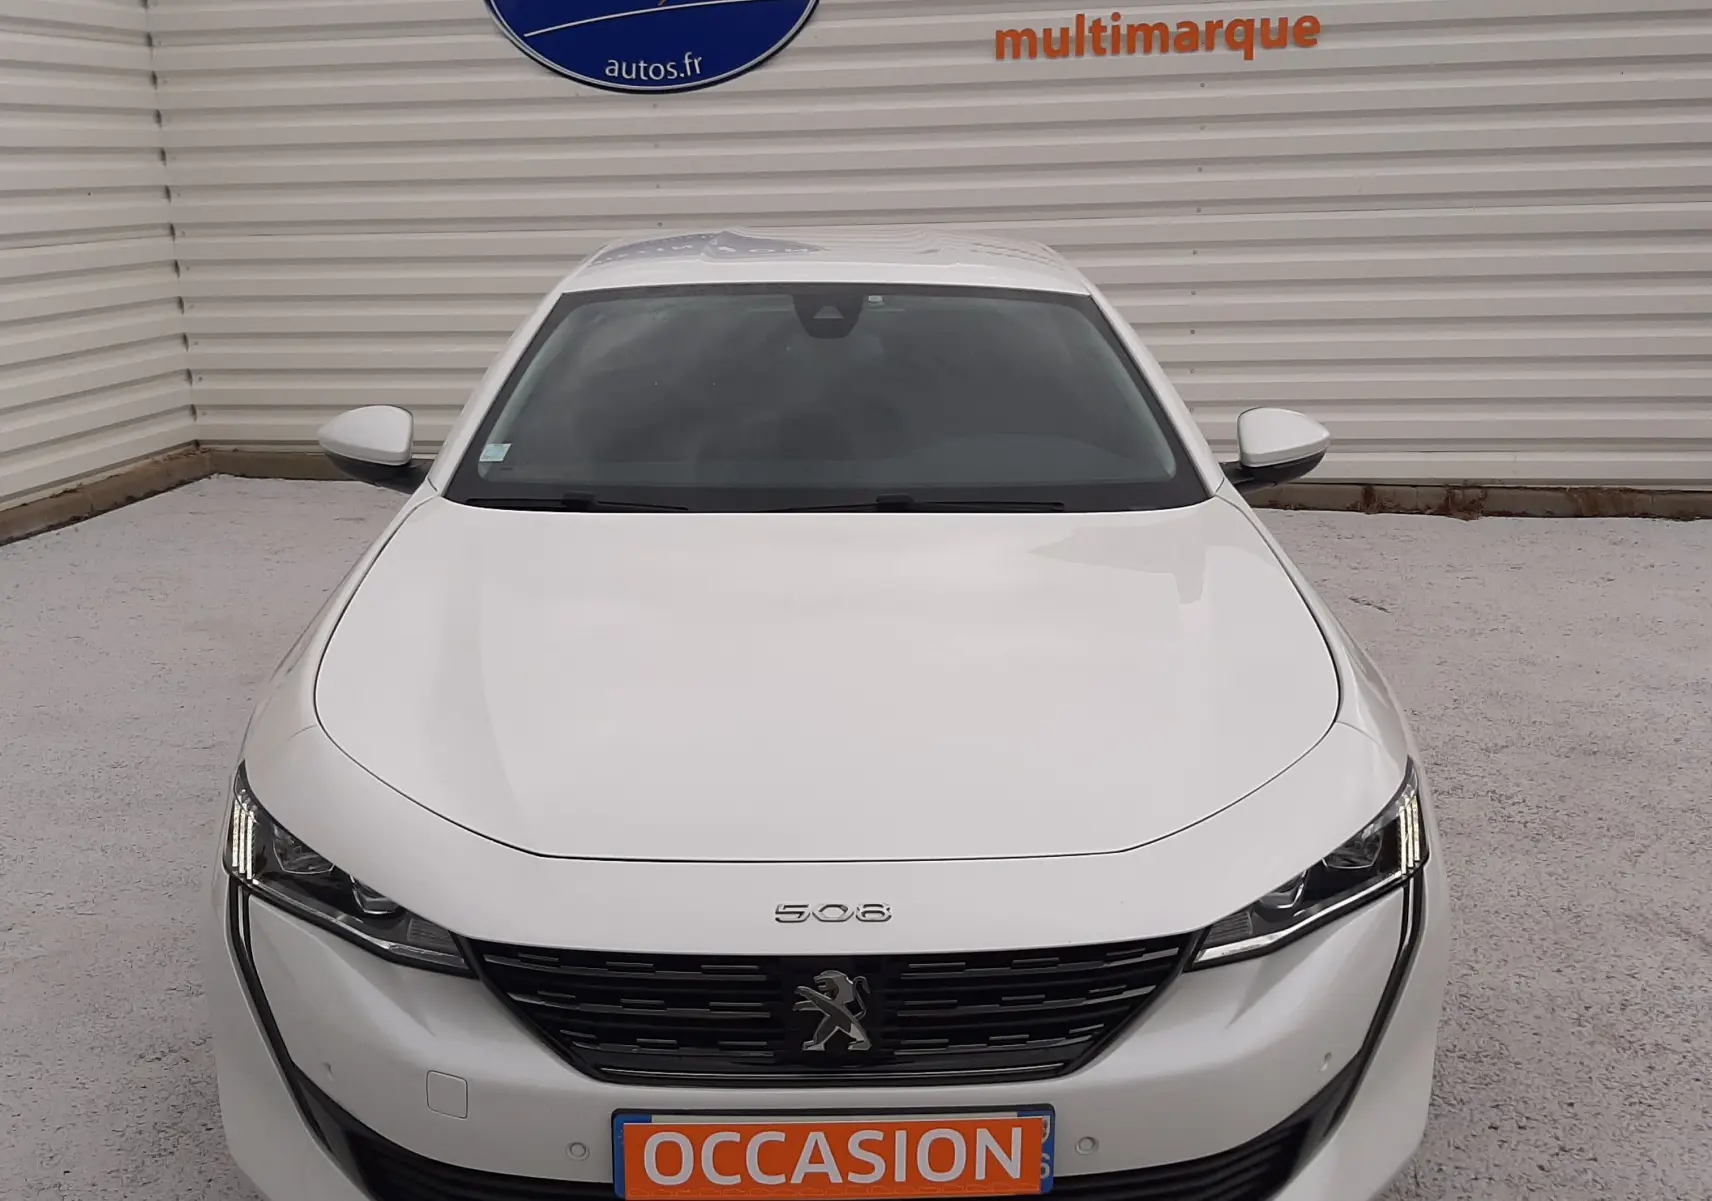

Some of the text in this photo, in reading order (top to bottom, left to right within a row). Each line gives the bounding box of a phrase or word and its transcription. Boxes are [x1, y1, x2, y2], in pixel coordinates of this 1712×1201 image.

[995, 12, 1321, 61] multimarque
[605, 52, 702, 80] autos.fr
[775, 903, 892, 923] 508
[643, 1127, 1022, 1185] OCCASION
